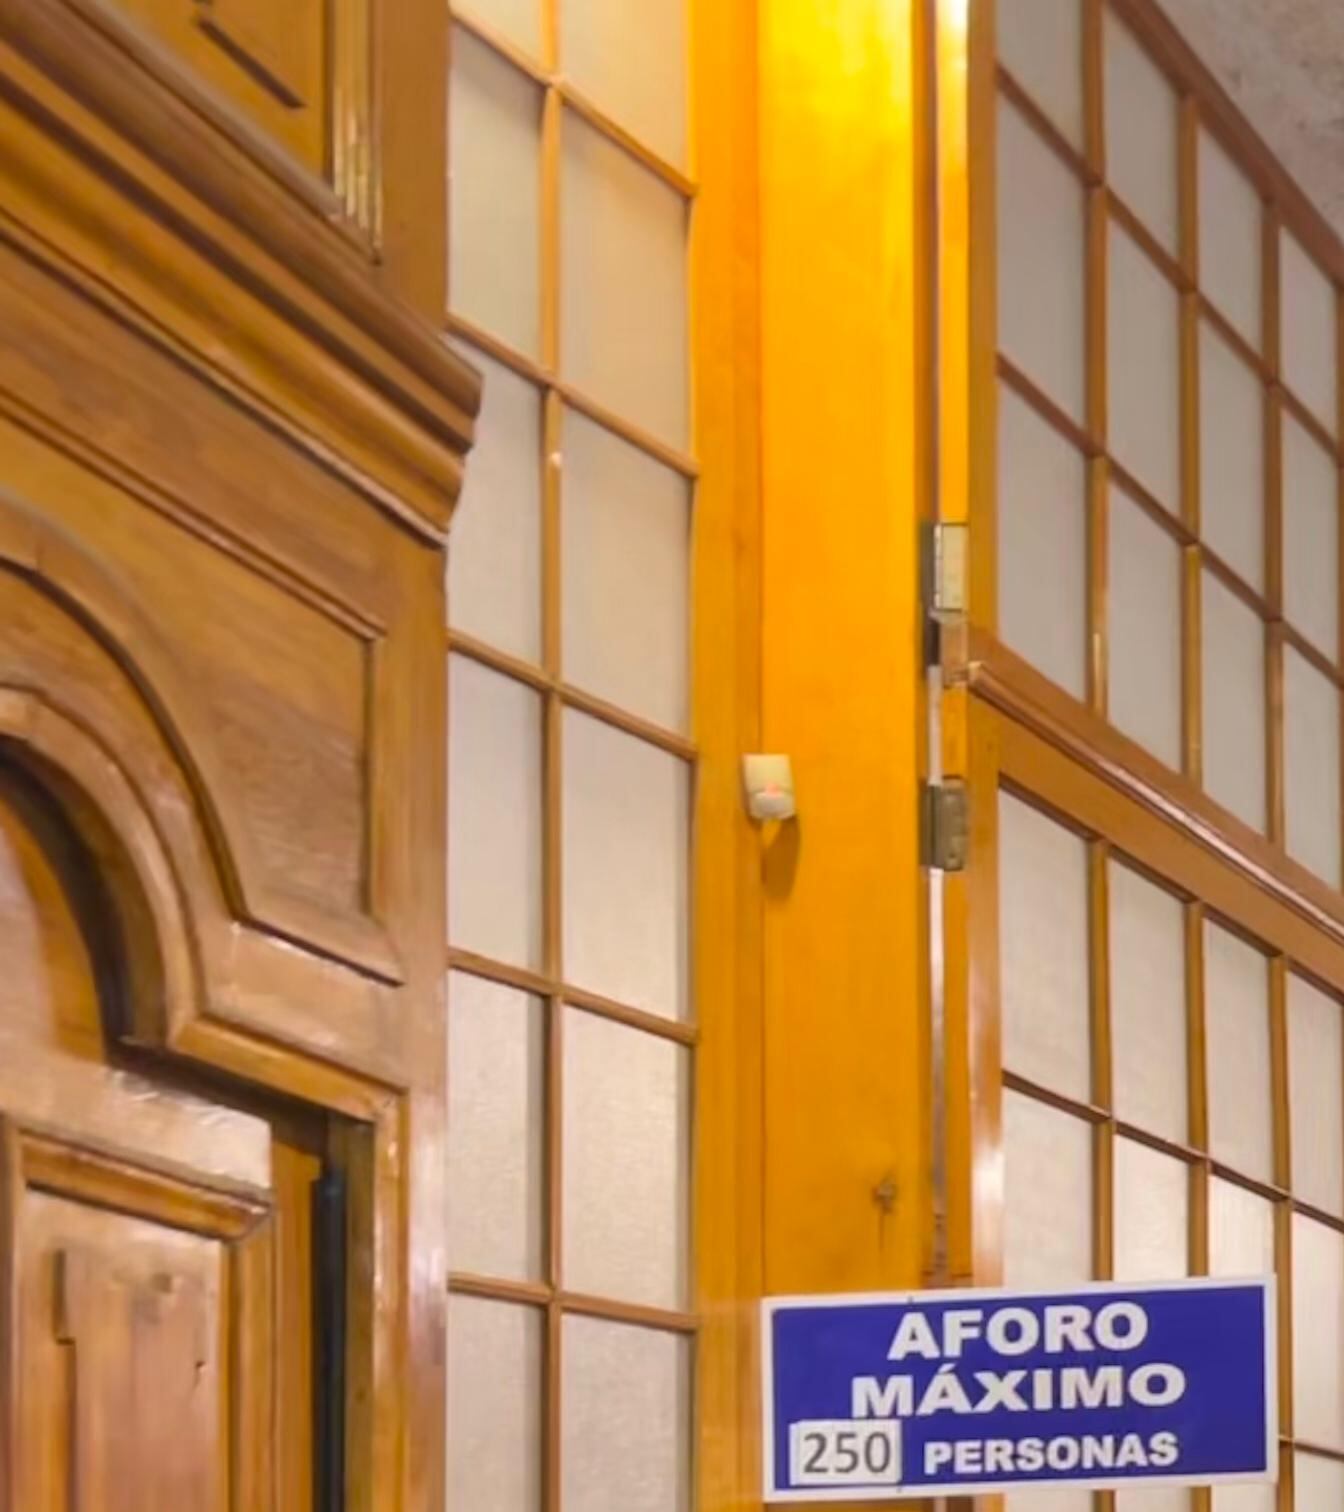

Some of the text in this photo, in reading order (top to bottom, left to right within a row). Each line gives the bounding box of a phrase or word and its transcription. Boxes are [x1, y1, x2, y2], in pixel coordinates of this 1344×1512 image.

[887, 1301, 1148, 1360] AFORO
[851, 1363, 1186, 1419] MÁXIMO
[802, 1431, 1179, 1475] 250 PERSONAS
